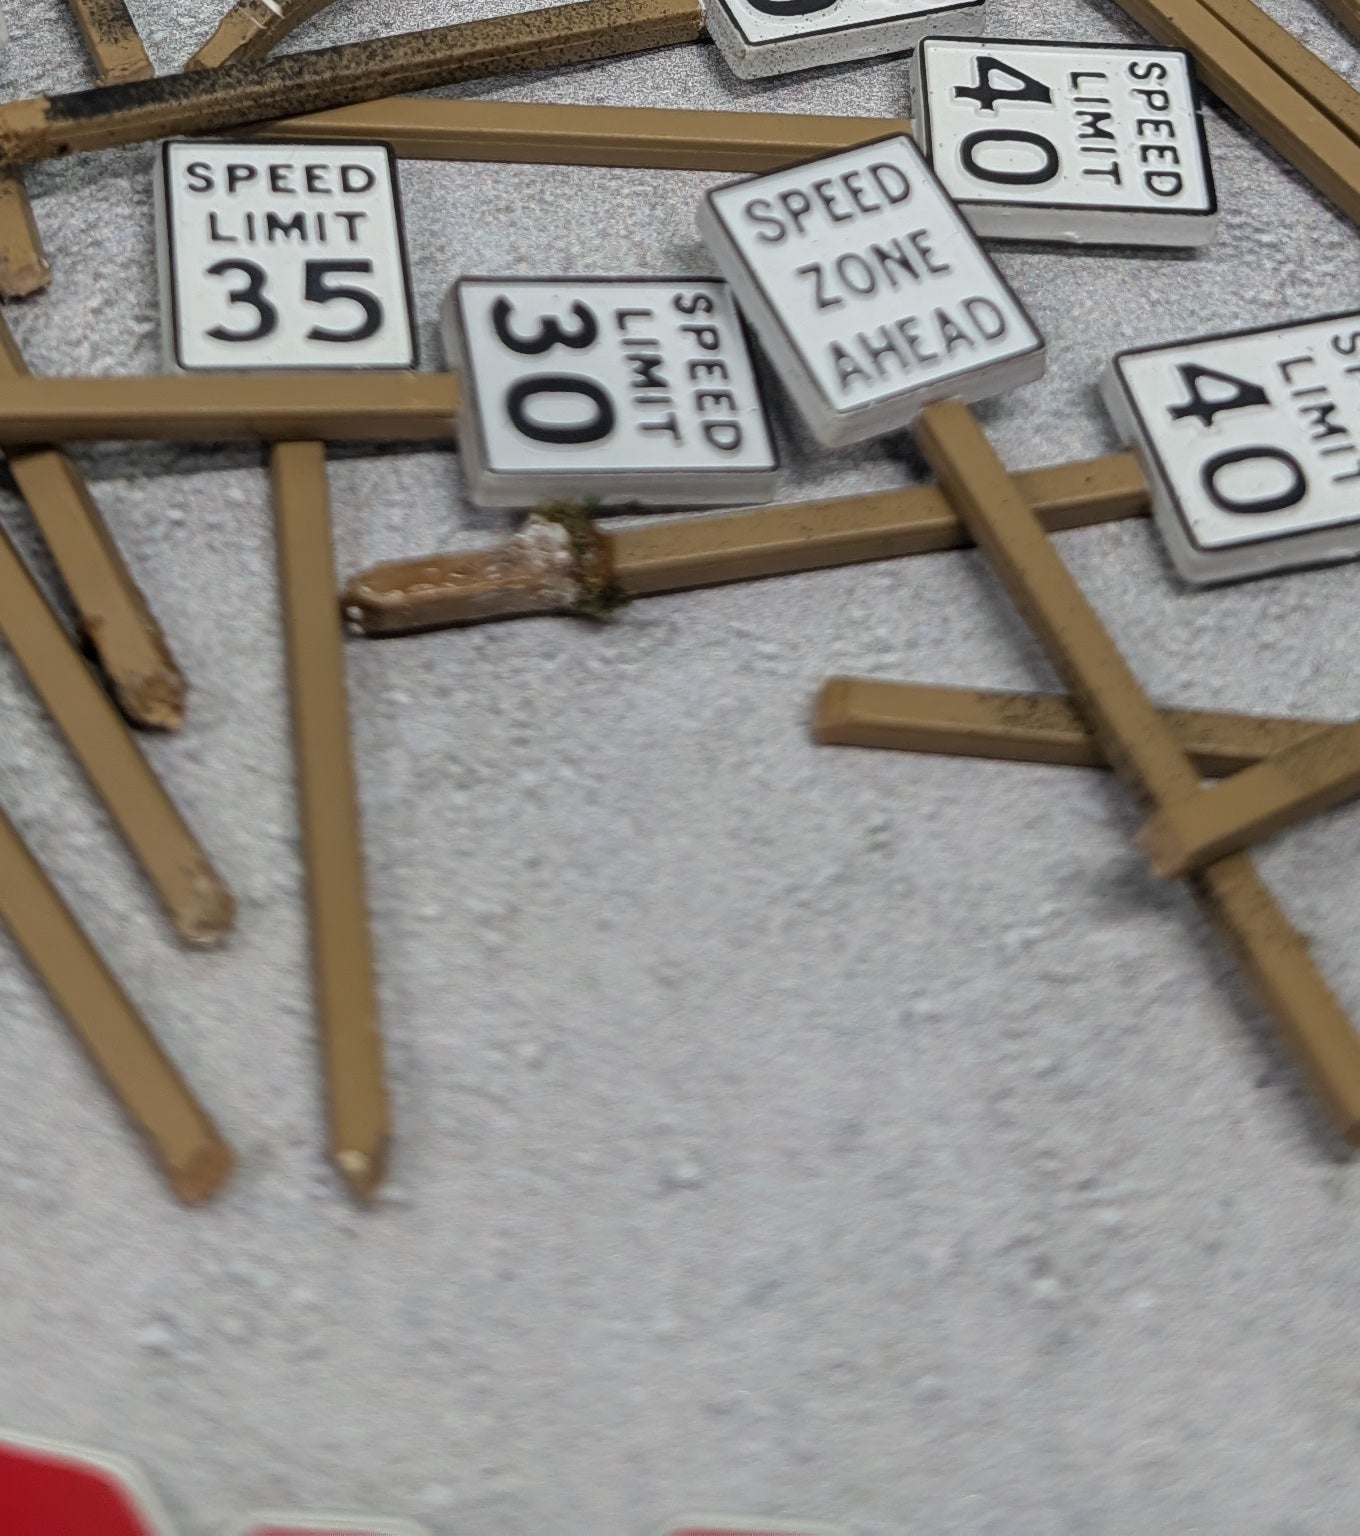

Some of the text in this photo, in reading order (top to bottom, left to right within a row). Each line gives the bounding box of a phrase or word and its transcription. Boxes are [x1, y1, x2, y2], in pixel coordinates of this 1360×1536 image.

[187, 162, 376, 194] SPEED
[955, 55, 1059, 186] 40
[1070, 71, 1122, 188] LIMIT
[1128, 60, 1183, 198] SPEED
[209, 210, 369, 244] LIMIT
[745, 163, 911, 242] SPEED
[205, 258, 385, 344] 35
[799, 228, 949, 310] ZONE
[493, 295, 614, 444] 30
[614, 306, 682, 447] LIMIT
[674, 291, 742, 452] SPEED
[828, 297, 1006, 392] AHEAD
[1168, 360, 1307, 513] 40
